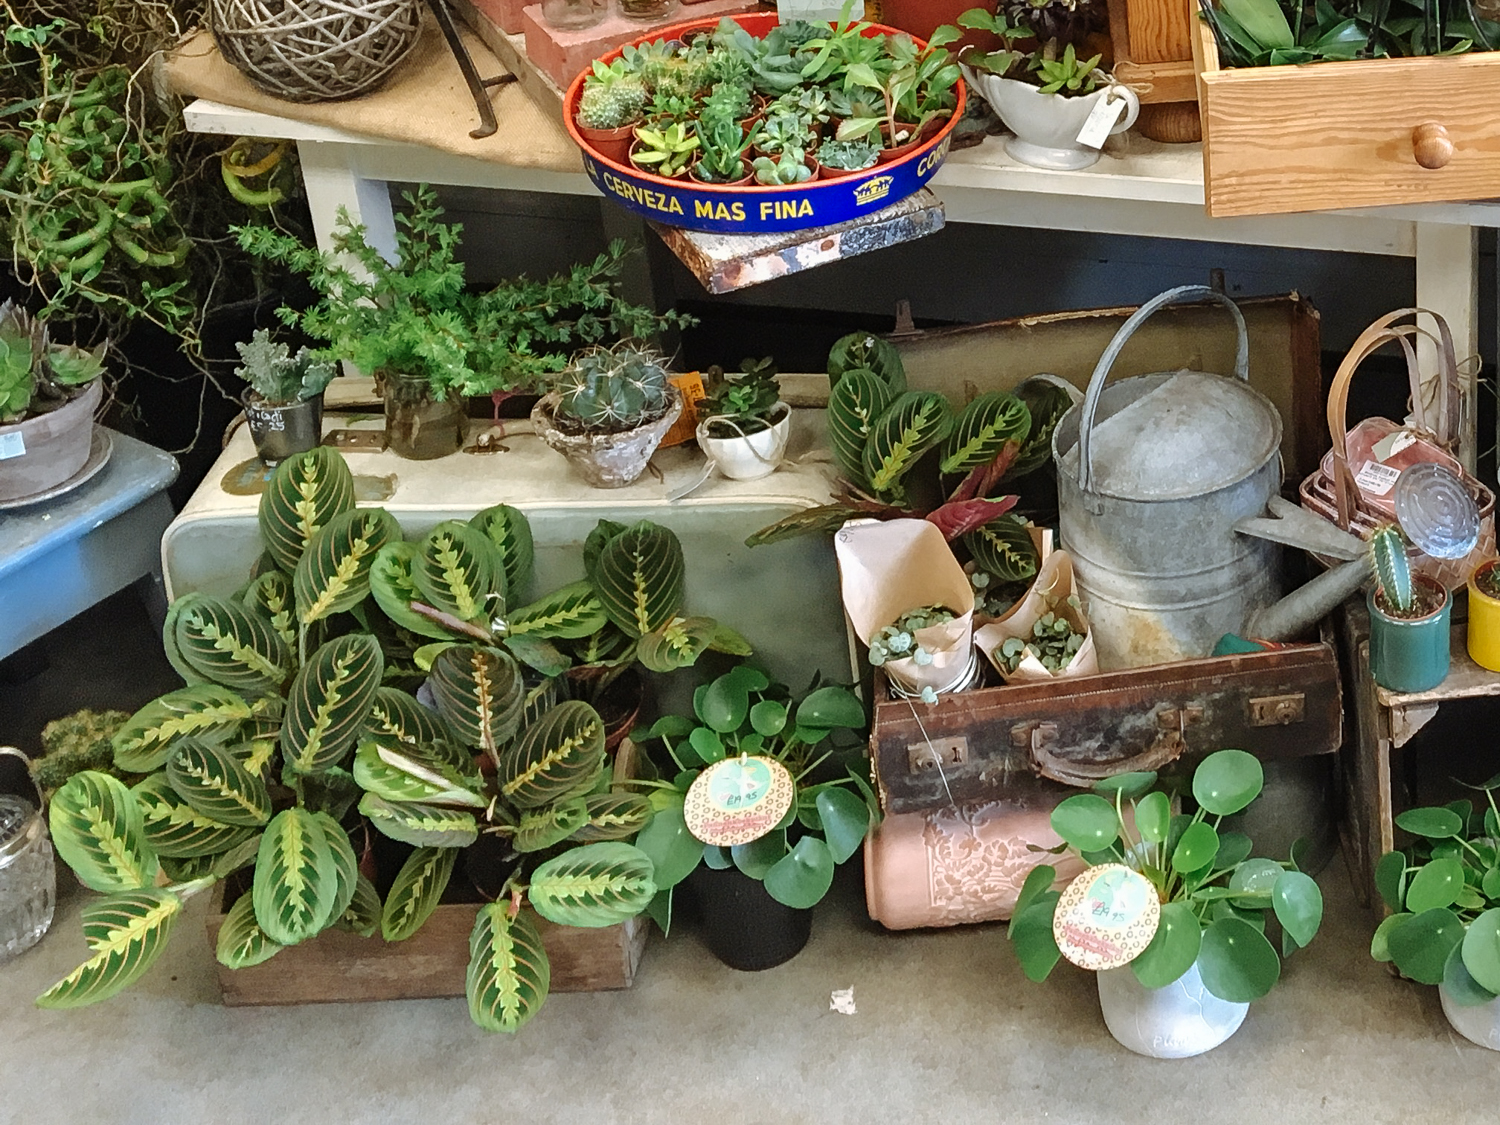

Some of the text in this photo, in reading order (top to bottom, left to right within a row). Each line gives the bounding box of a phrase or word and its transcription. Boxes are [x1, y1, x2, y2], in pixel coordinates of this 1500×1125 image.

[603, 174, 684, 216] CERVEZA
[695, 200, 746, 222] MAS
[759, 198, 815, 221] FINA
